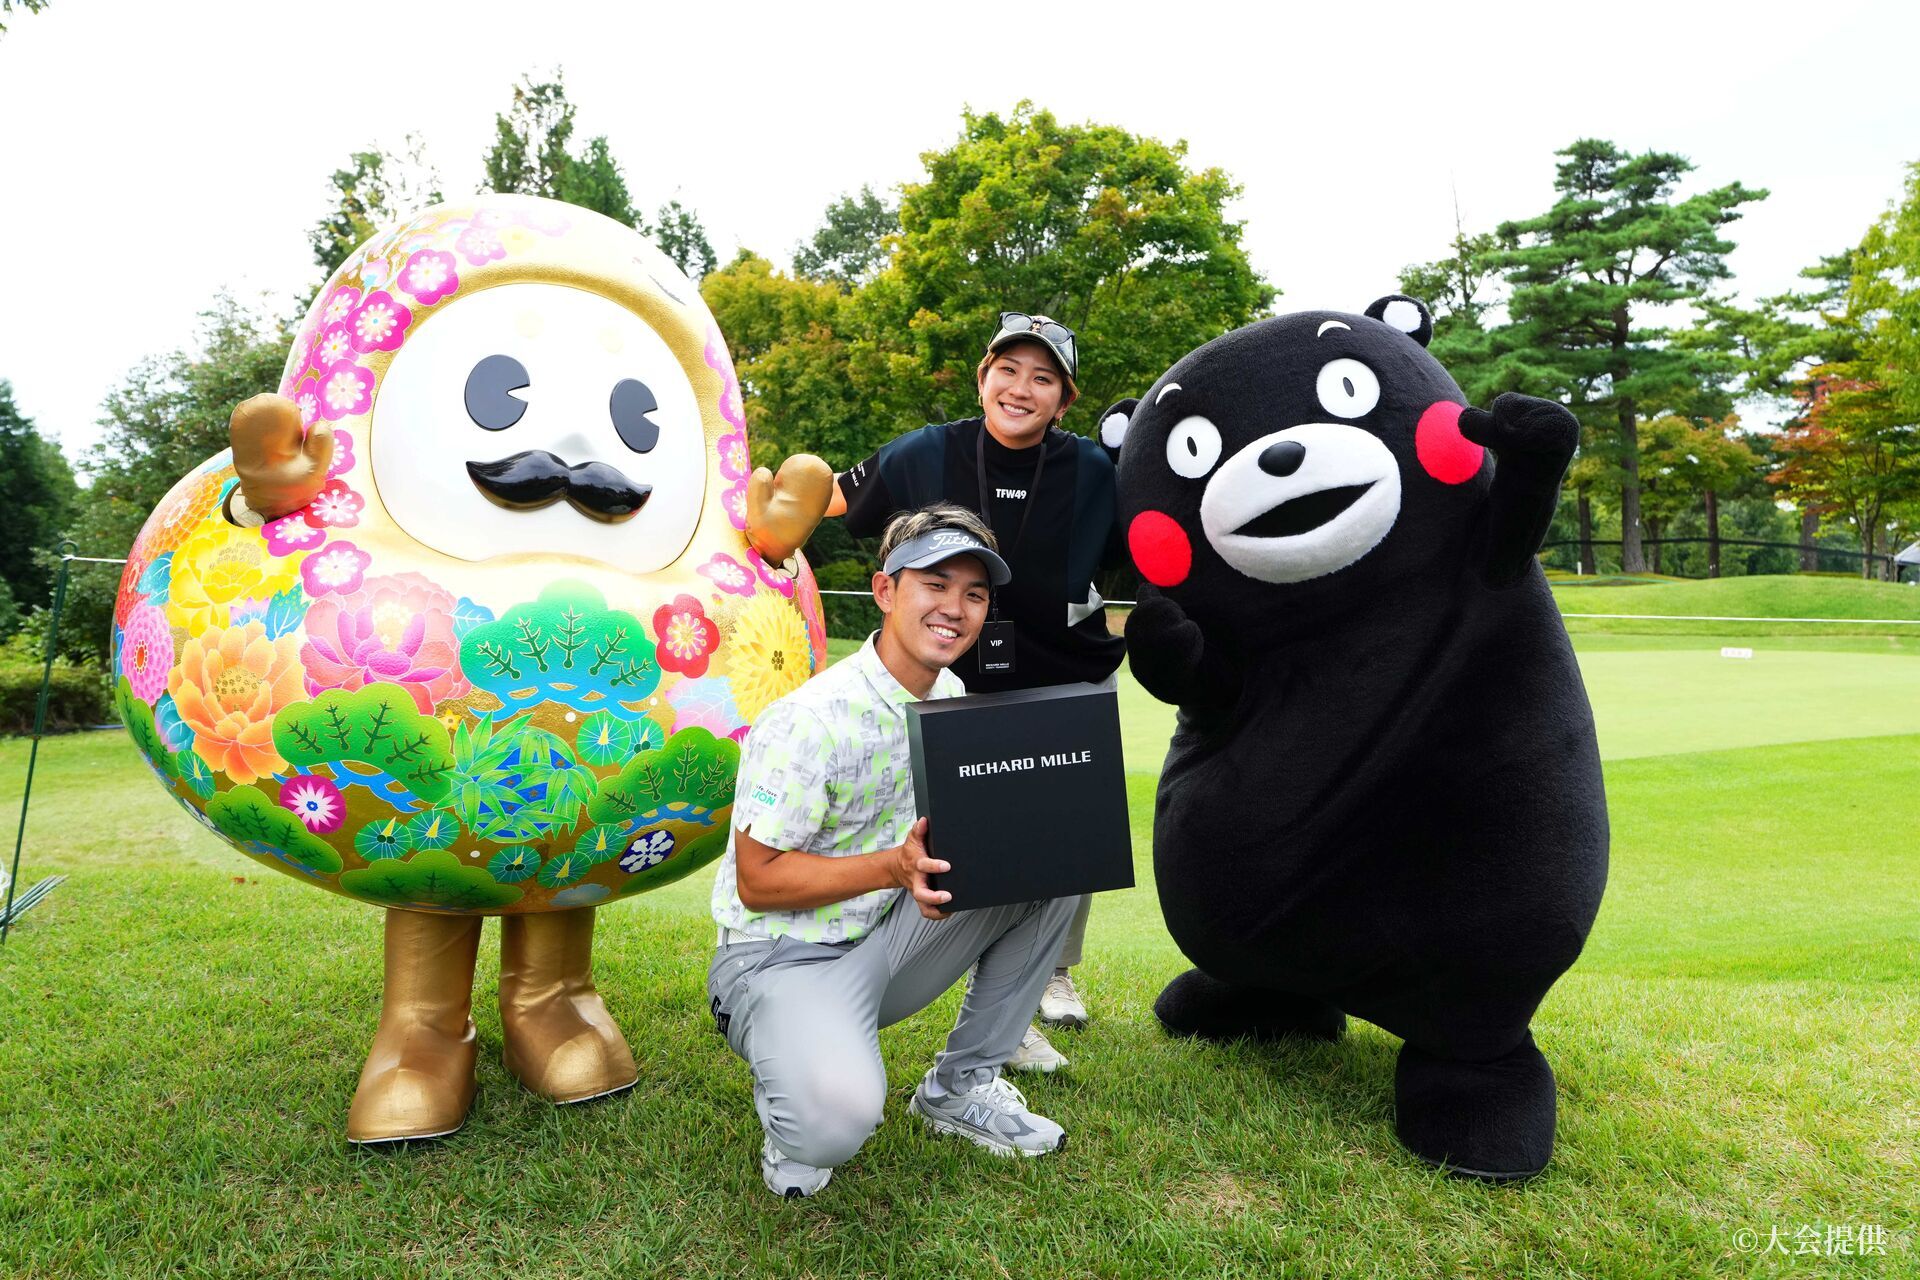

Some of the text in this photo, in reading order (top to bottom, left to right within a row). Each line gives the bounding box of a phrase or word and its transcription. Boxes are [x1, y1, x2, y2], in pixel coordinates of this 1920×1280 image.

[995, 488, 1027, 500] TFW49
[928, 531, 983, 550] Titlei
[990, 639, 1003, 647] VIP
[958, 750, 1092, 778] RICHARD MILLE
[962, 1103, 993, 1128] N
